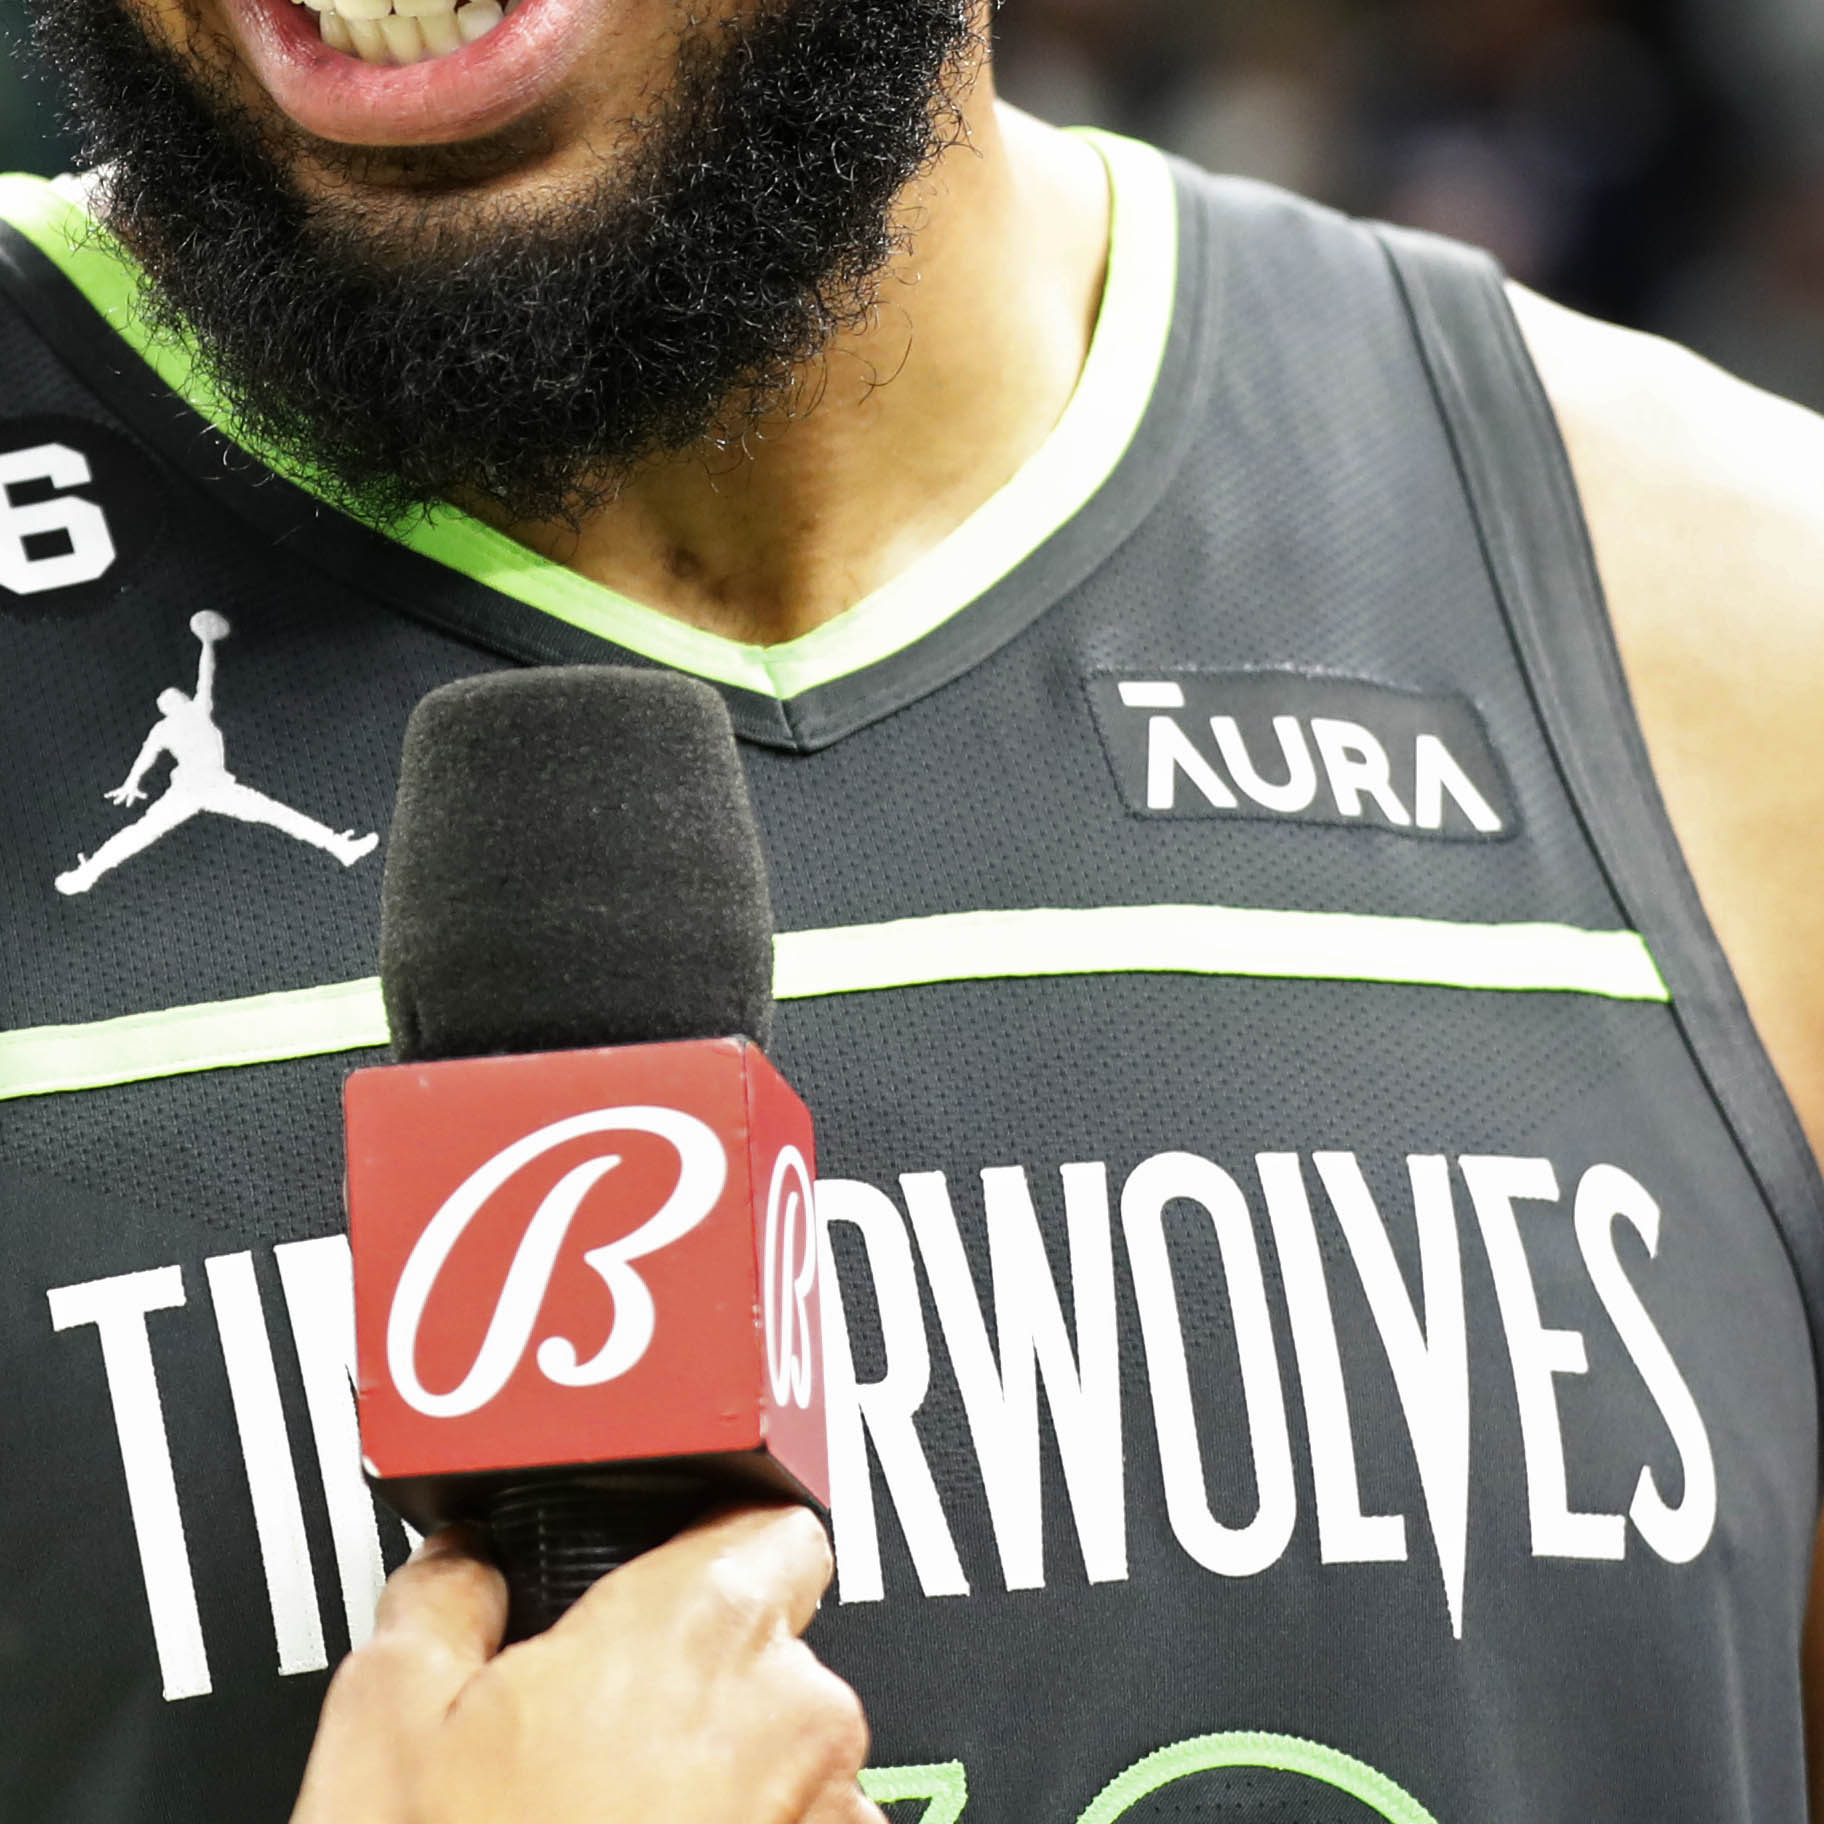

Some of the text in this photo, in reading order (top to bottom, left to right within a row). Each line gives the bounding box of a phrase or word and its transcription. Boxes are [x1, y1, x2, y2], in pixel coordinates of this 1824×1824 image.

[386, 1105, 728, 1419] B
[763, 1144, 817, 1410] B
[46, 1151, 1717, 1702] TIRWOLVES
